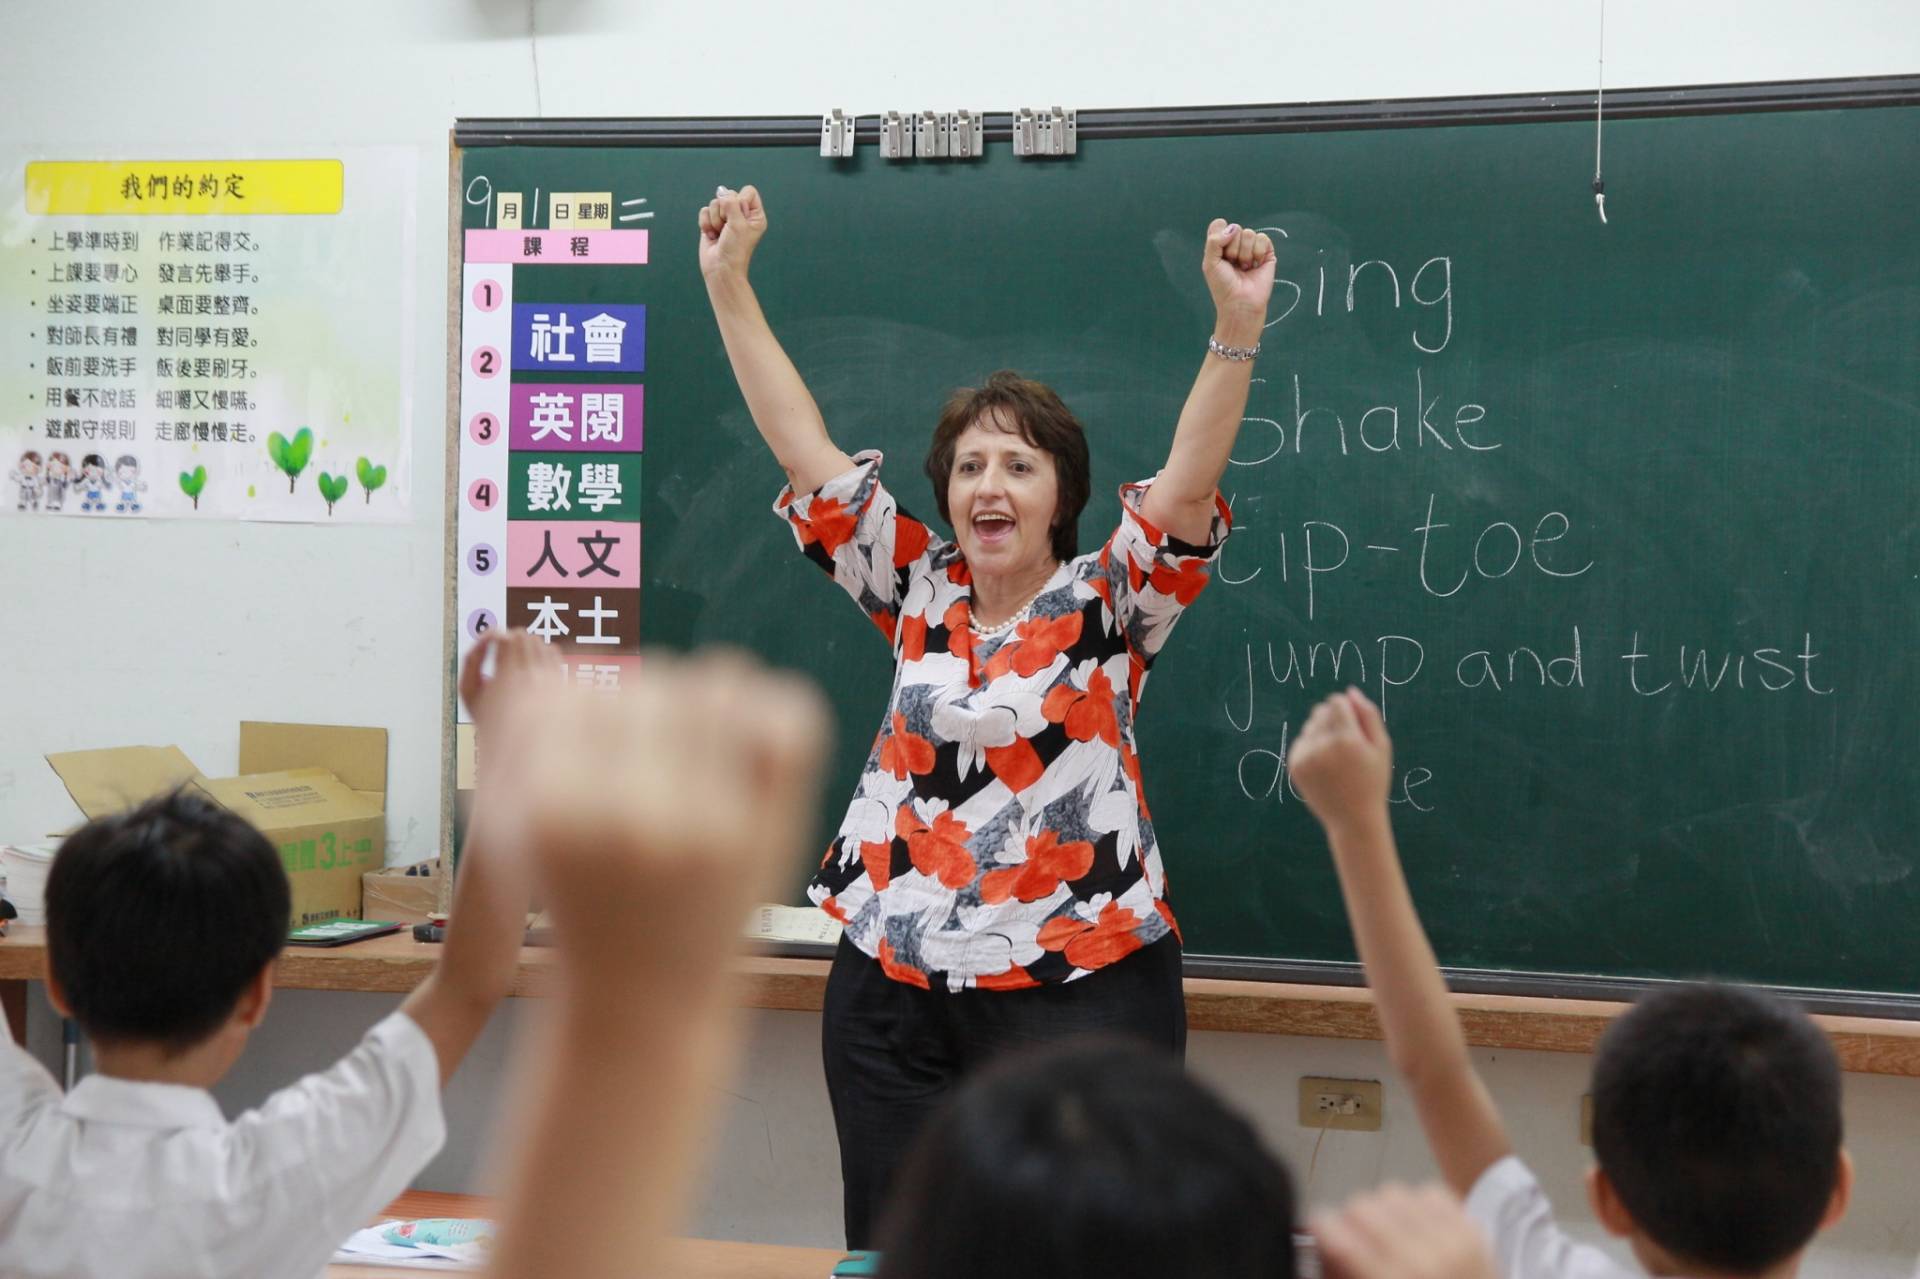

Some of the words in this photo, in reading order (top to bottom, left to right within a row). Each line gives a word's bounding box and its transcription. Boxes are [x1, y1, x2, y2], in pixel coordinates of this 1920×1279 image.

[121, 172, 246, 200] 我們的約定
[48, 232, 139, 252] 上學準時到
[48, 263, 138, 283] 上課要專心
[47, 295, 138, 314] 坐姿要端正
[483, 284, 492, 307] 1
[47, 326, 138, 347] 對師長有禮
[529, 312, 627, 364] 社會
[46, 356, 137, 377] 飯前要洗手
[479, 351, 493, 374] 2
[478, 417, 492, 440] 3
[528, 391, 624, 443] 英閱
[475, 484, 491, 507] 4
[526, 462, 622, 513] 數學
[475, 549, 490, 572] 5
[526, 529, 621, 578] 人文
[526, 595, 621, 645] 本土
[1224, 628, 1424, 732] jump
[1455, 625, 1585, 691] and
[1620, 631, 1835, 696] twist
